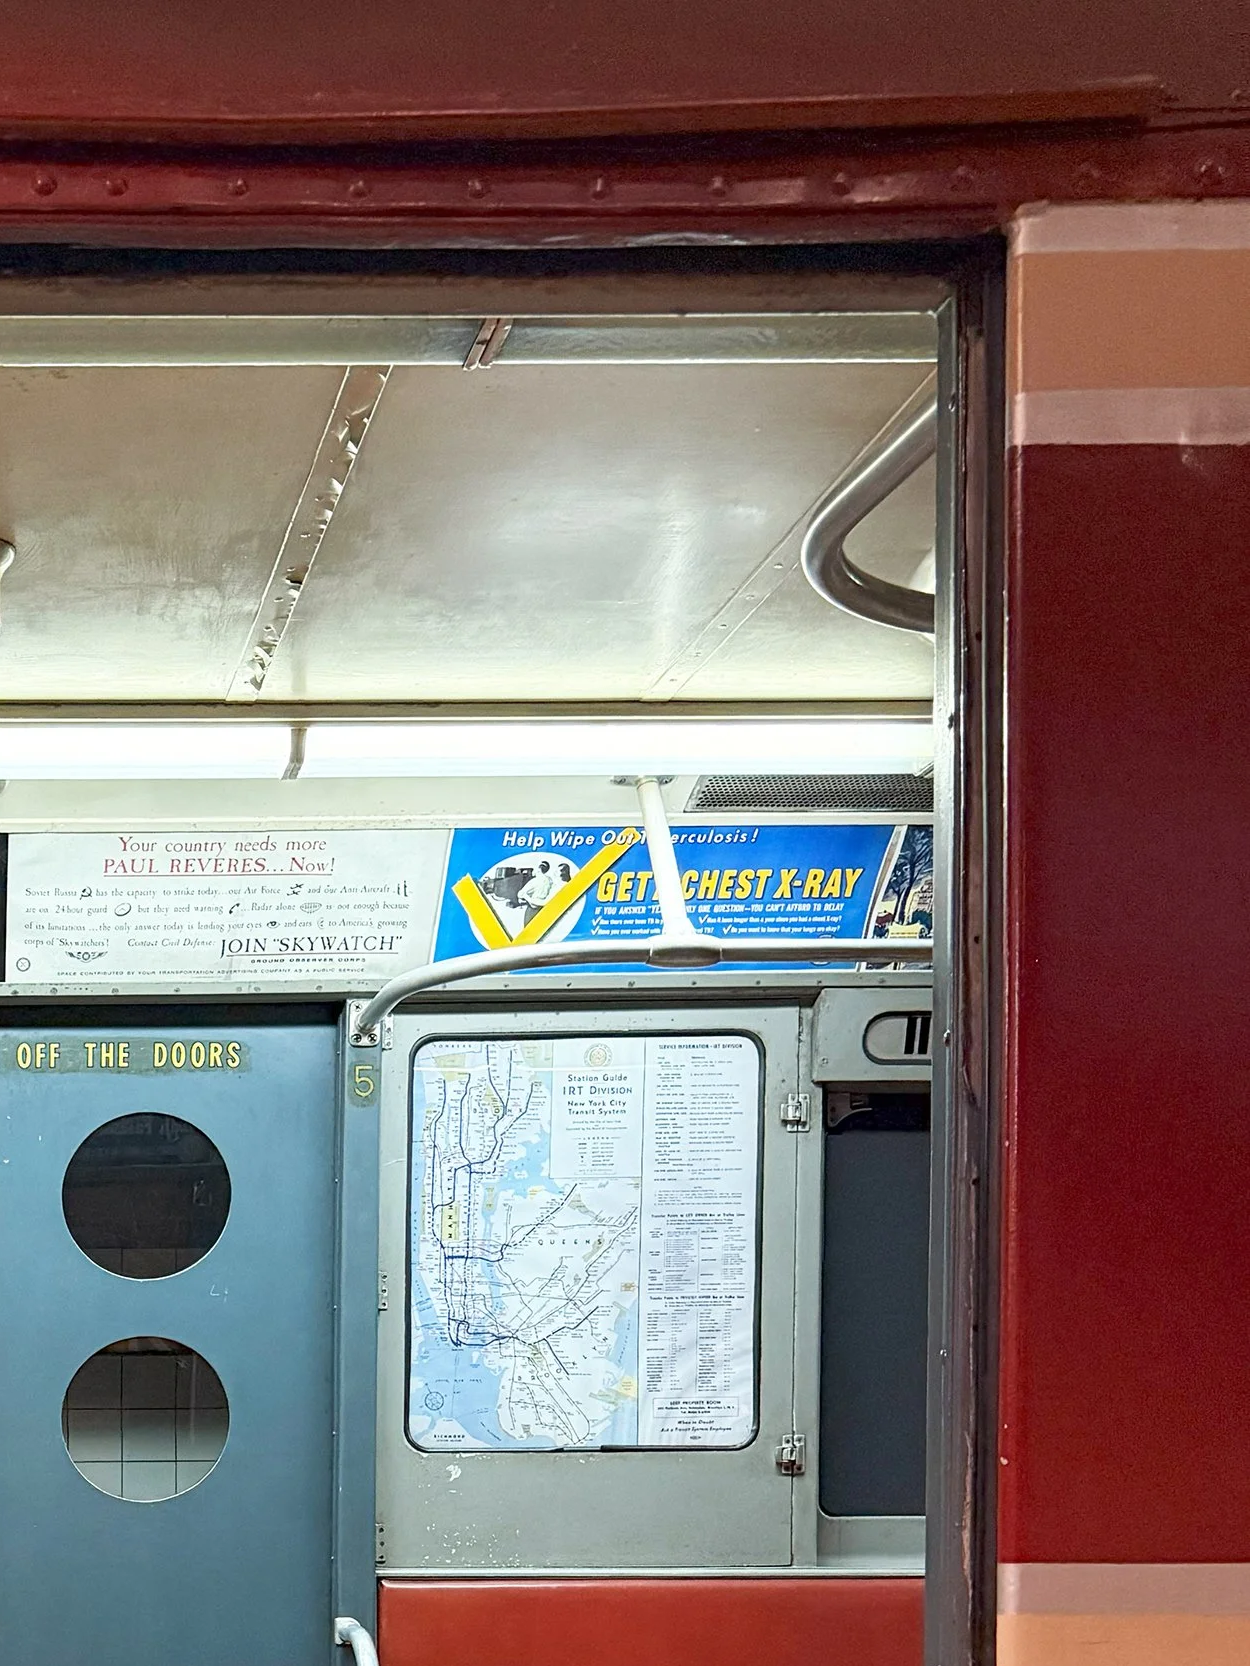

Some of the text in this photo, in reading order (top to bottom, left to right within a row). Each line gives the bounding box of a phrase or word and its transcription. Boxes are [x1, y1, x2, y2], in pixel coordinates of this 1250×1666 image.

[118, 835, 327, 857] Your country needs more
[502, 828, 759, 851] Help Wipe Out Terculosis!
[103, 858, 159, 873] PAUL
[289, 857, 335, 873] Now!
[597, 871, 654, 902] GET
[681, 868, 773, 901] CHEST
[773, 867, 864, 899] X-RAY
[95, 888, 108, 896] has
[111, 888, 123, 896] the
[127, 889, 157, 899] capacity
[174, 888, 194, 896] strike
[261, 886, 280, 894] Force
[87, 905, 107, 916] guard
[138, 905, 150, 913] but
[154, 905, 169, 916] they
[173, 905, 190, 913] need
[193, 905, 223, 915] warning
[275, 902, 295, 911] alone
[382, 902, 409, 910] because
[604, 906, 616, 914] YOU
[619, 906, 646, 914] ANSWER
[786, 903, 810, 912] AFFORD
[812, 903, 821, 911] TO
[823, 903, 845, 911] DELAY
[115, 922, 130, 933] only
[163, 922, 184, 932] today
[377, 919, 408, 929] growing
[24, 939, 45, 948] corps
[46, 938, 54, 946] of
[220, 938, 267, 959] JOIN
[273, 935, 403, 952] "SKYWATCH"
[16, 1041, 242, 1069] OFF THE DOORS
[353, 1064, 375, 1098] 5
[568, 1073, 628, 1082] Station Guide
[563, 1085, 632, 1095] IRT DIVISION
[610, 1099, 626, 1108] City
[598, 1108, 626, 1116] System
